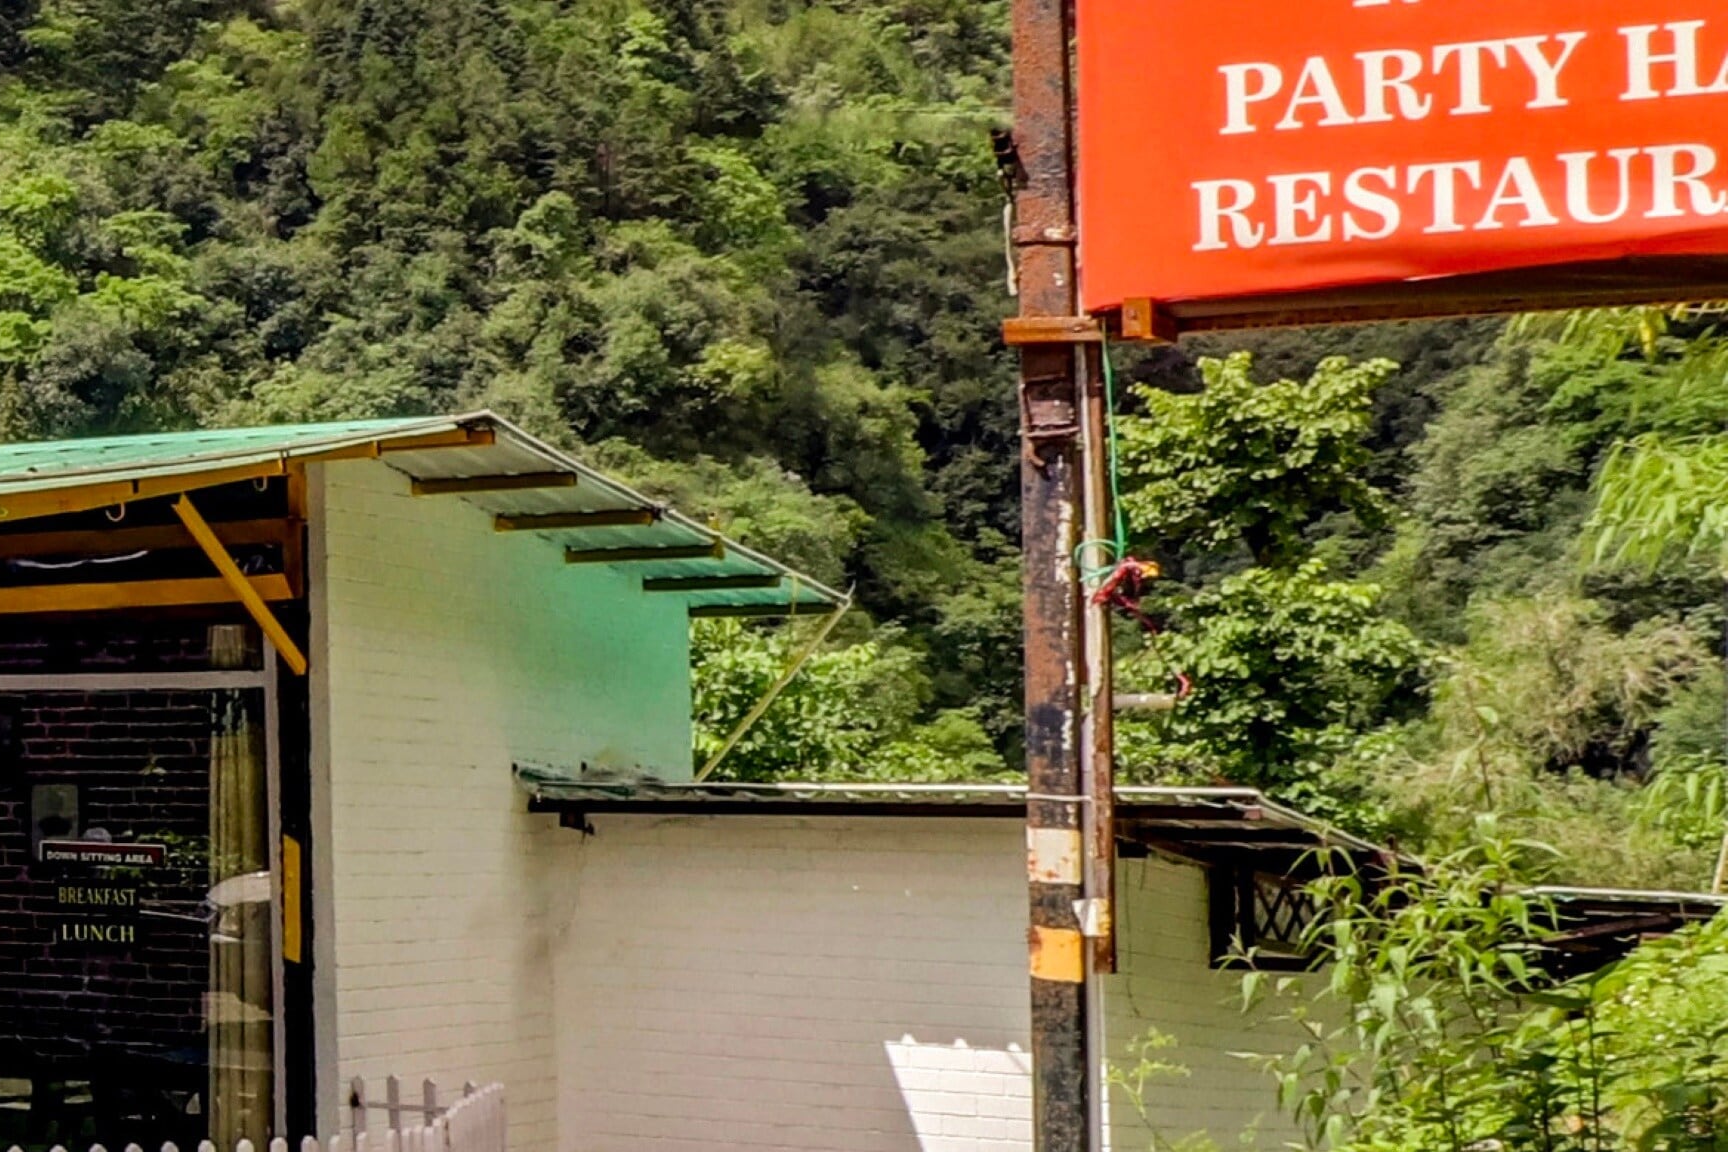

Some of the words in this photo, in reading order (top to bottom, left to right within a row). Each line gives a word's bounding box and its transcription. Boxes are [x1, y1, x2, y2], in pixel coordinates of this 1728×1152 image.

[1216, 31, 1587, 136] PARTY
[1190, 143, 1728, 252] RESTAUR
[80, 851, 122, 863] SITTING
[124, 853, 154, 864] AREA
[58, 886, 137, 907] BREAKFAST
[61, 923, 135, 943] LUNCH
